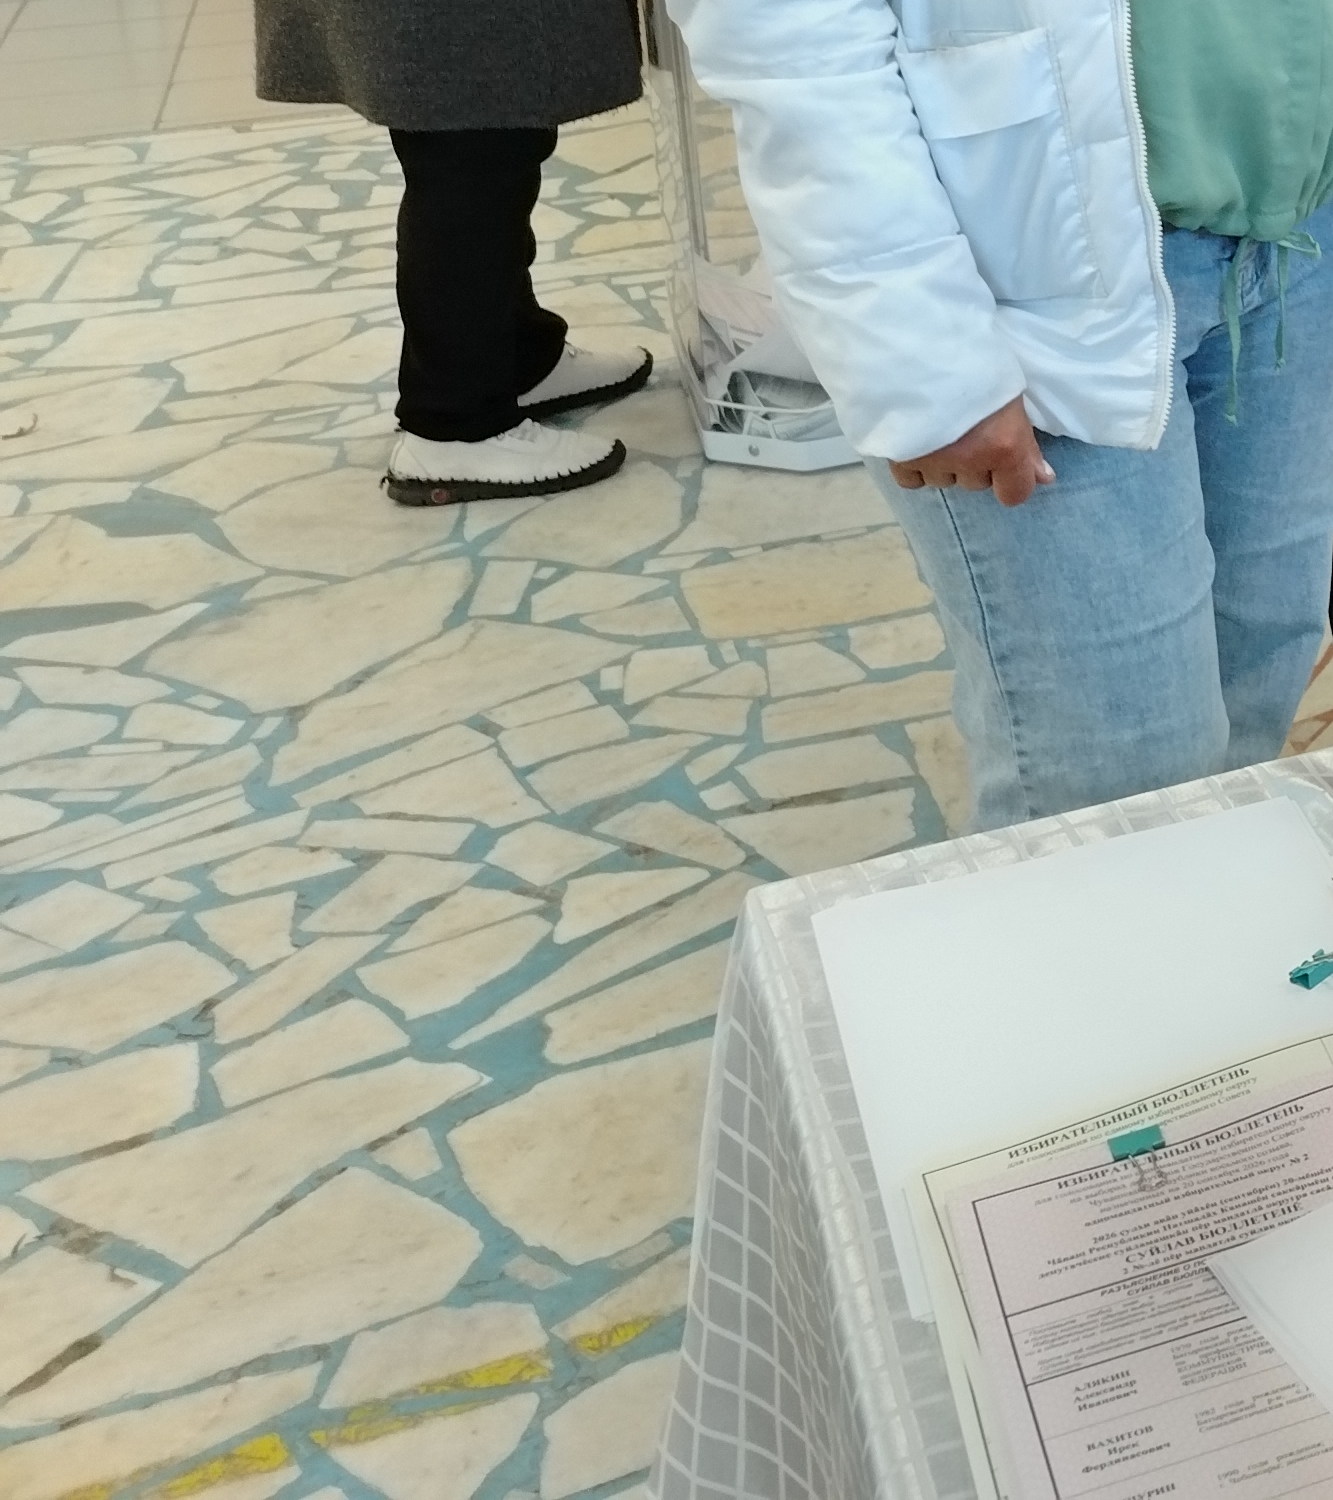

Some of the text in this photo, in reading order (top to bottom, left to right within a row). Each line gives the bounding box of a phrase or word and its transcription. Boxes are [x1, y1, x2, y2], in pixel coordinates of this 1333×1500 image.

[1008, 1066, 1250, 1159] ИЗБИРАТЕЛЬНЫЙ БЮЛЛЕТЕНЬ
[1157, 1101, 1216, 1128] арственного
[1205, 1104, 1304, 1147] БЮЛЛЕТЕНЬ
[1125, 1235, 1196, 1264] СУЙЛАВ
